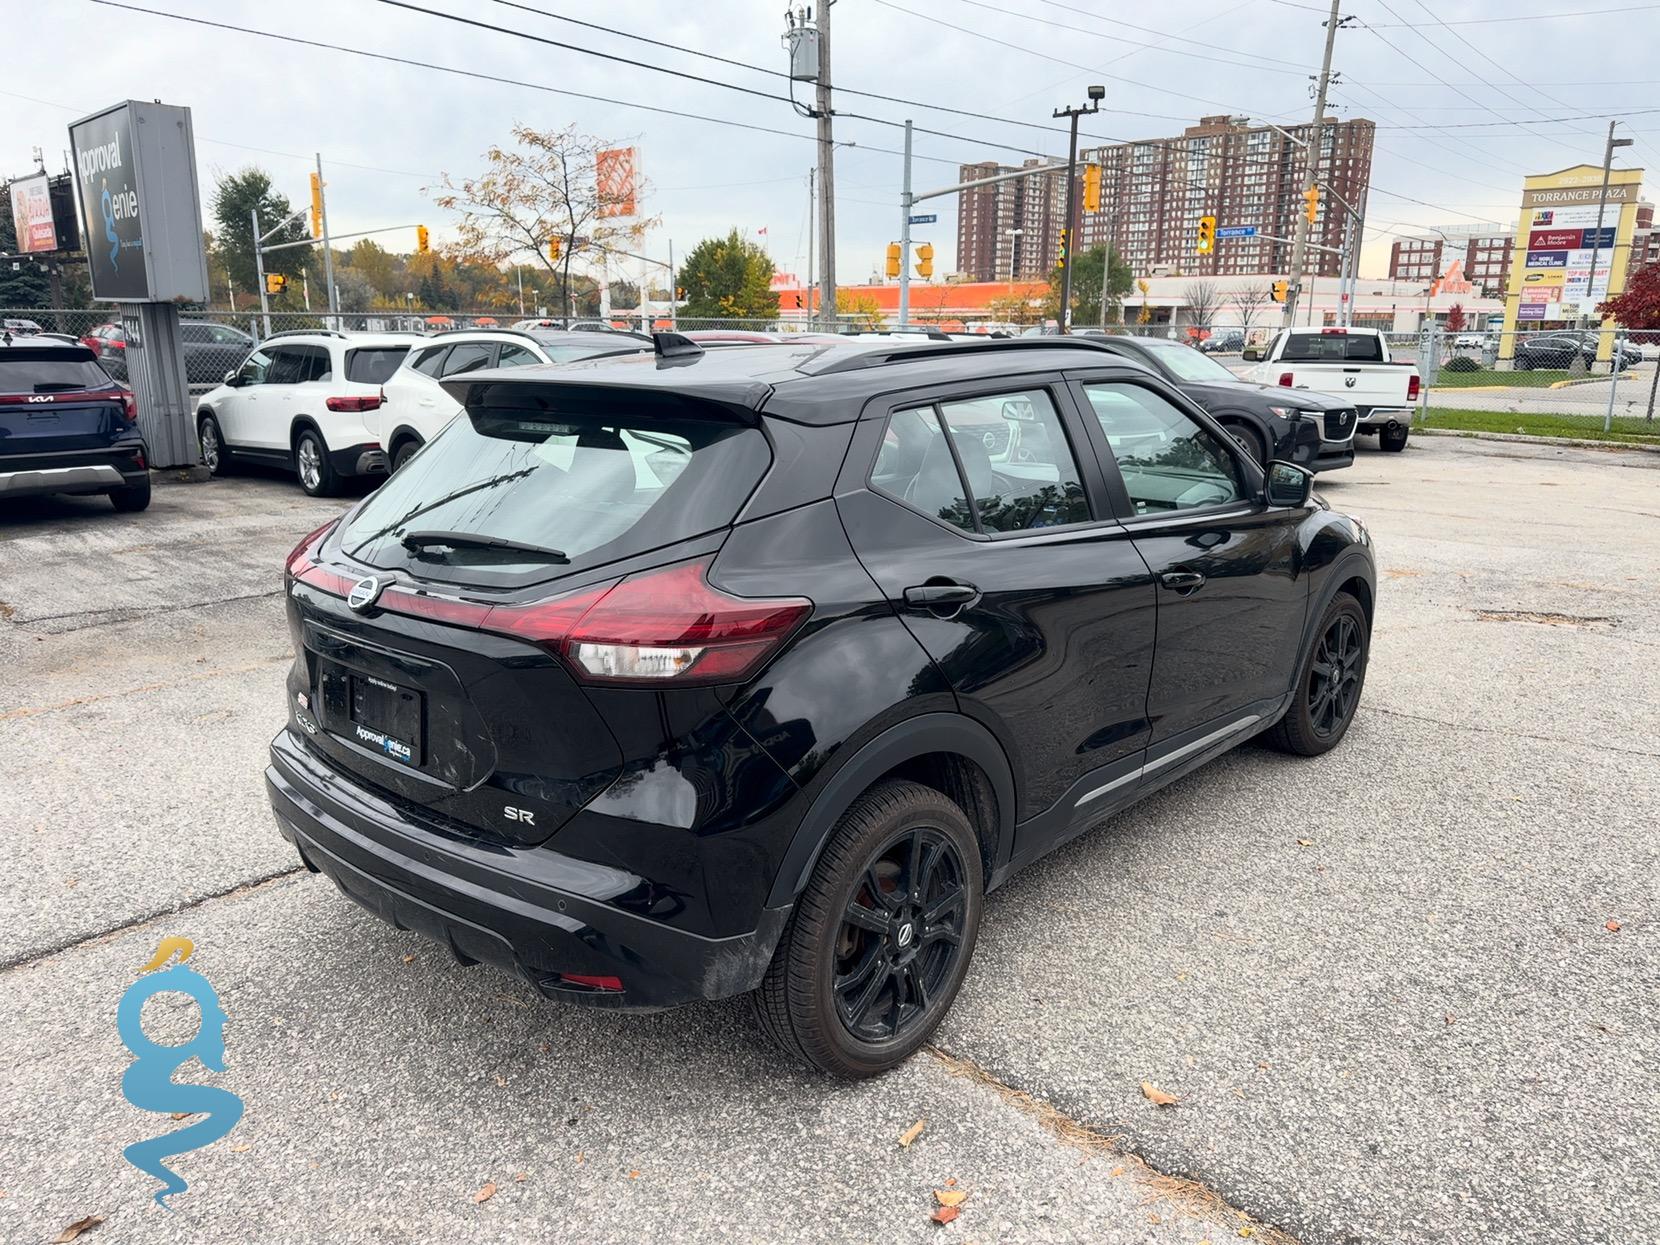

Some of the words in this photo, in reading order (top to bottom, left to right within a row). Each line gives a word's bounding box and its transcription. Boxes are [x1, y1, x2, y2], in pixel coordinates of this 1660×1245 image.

[77, 131, 122, 185] Approval
[1532, 190, 1590, 203] TORRANCE
[504, 806, 535, 826] SR
